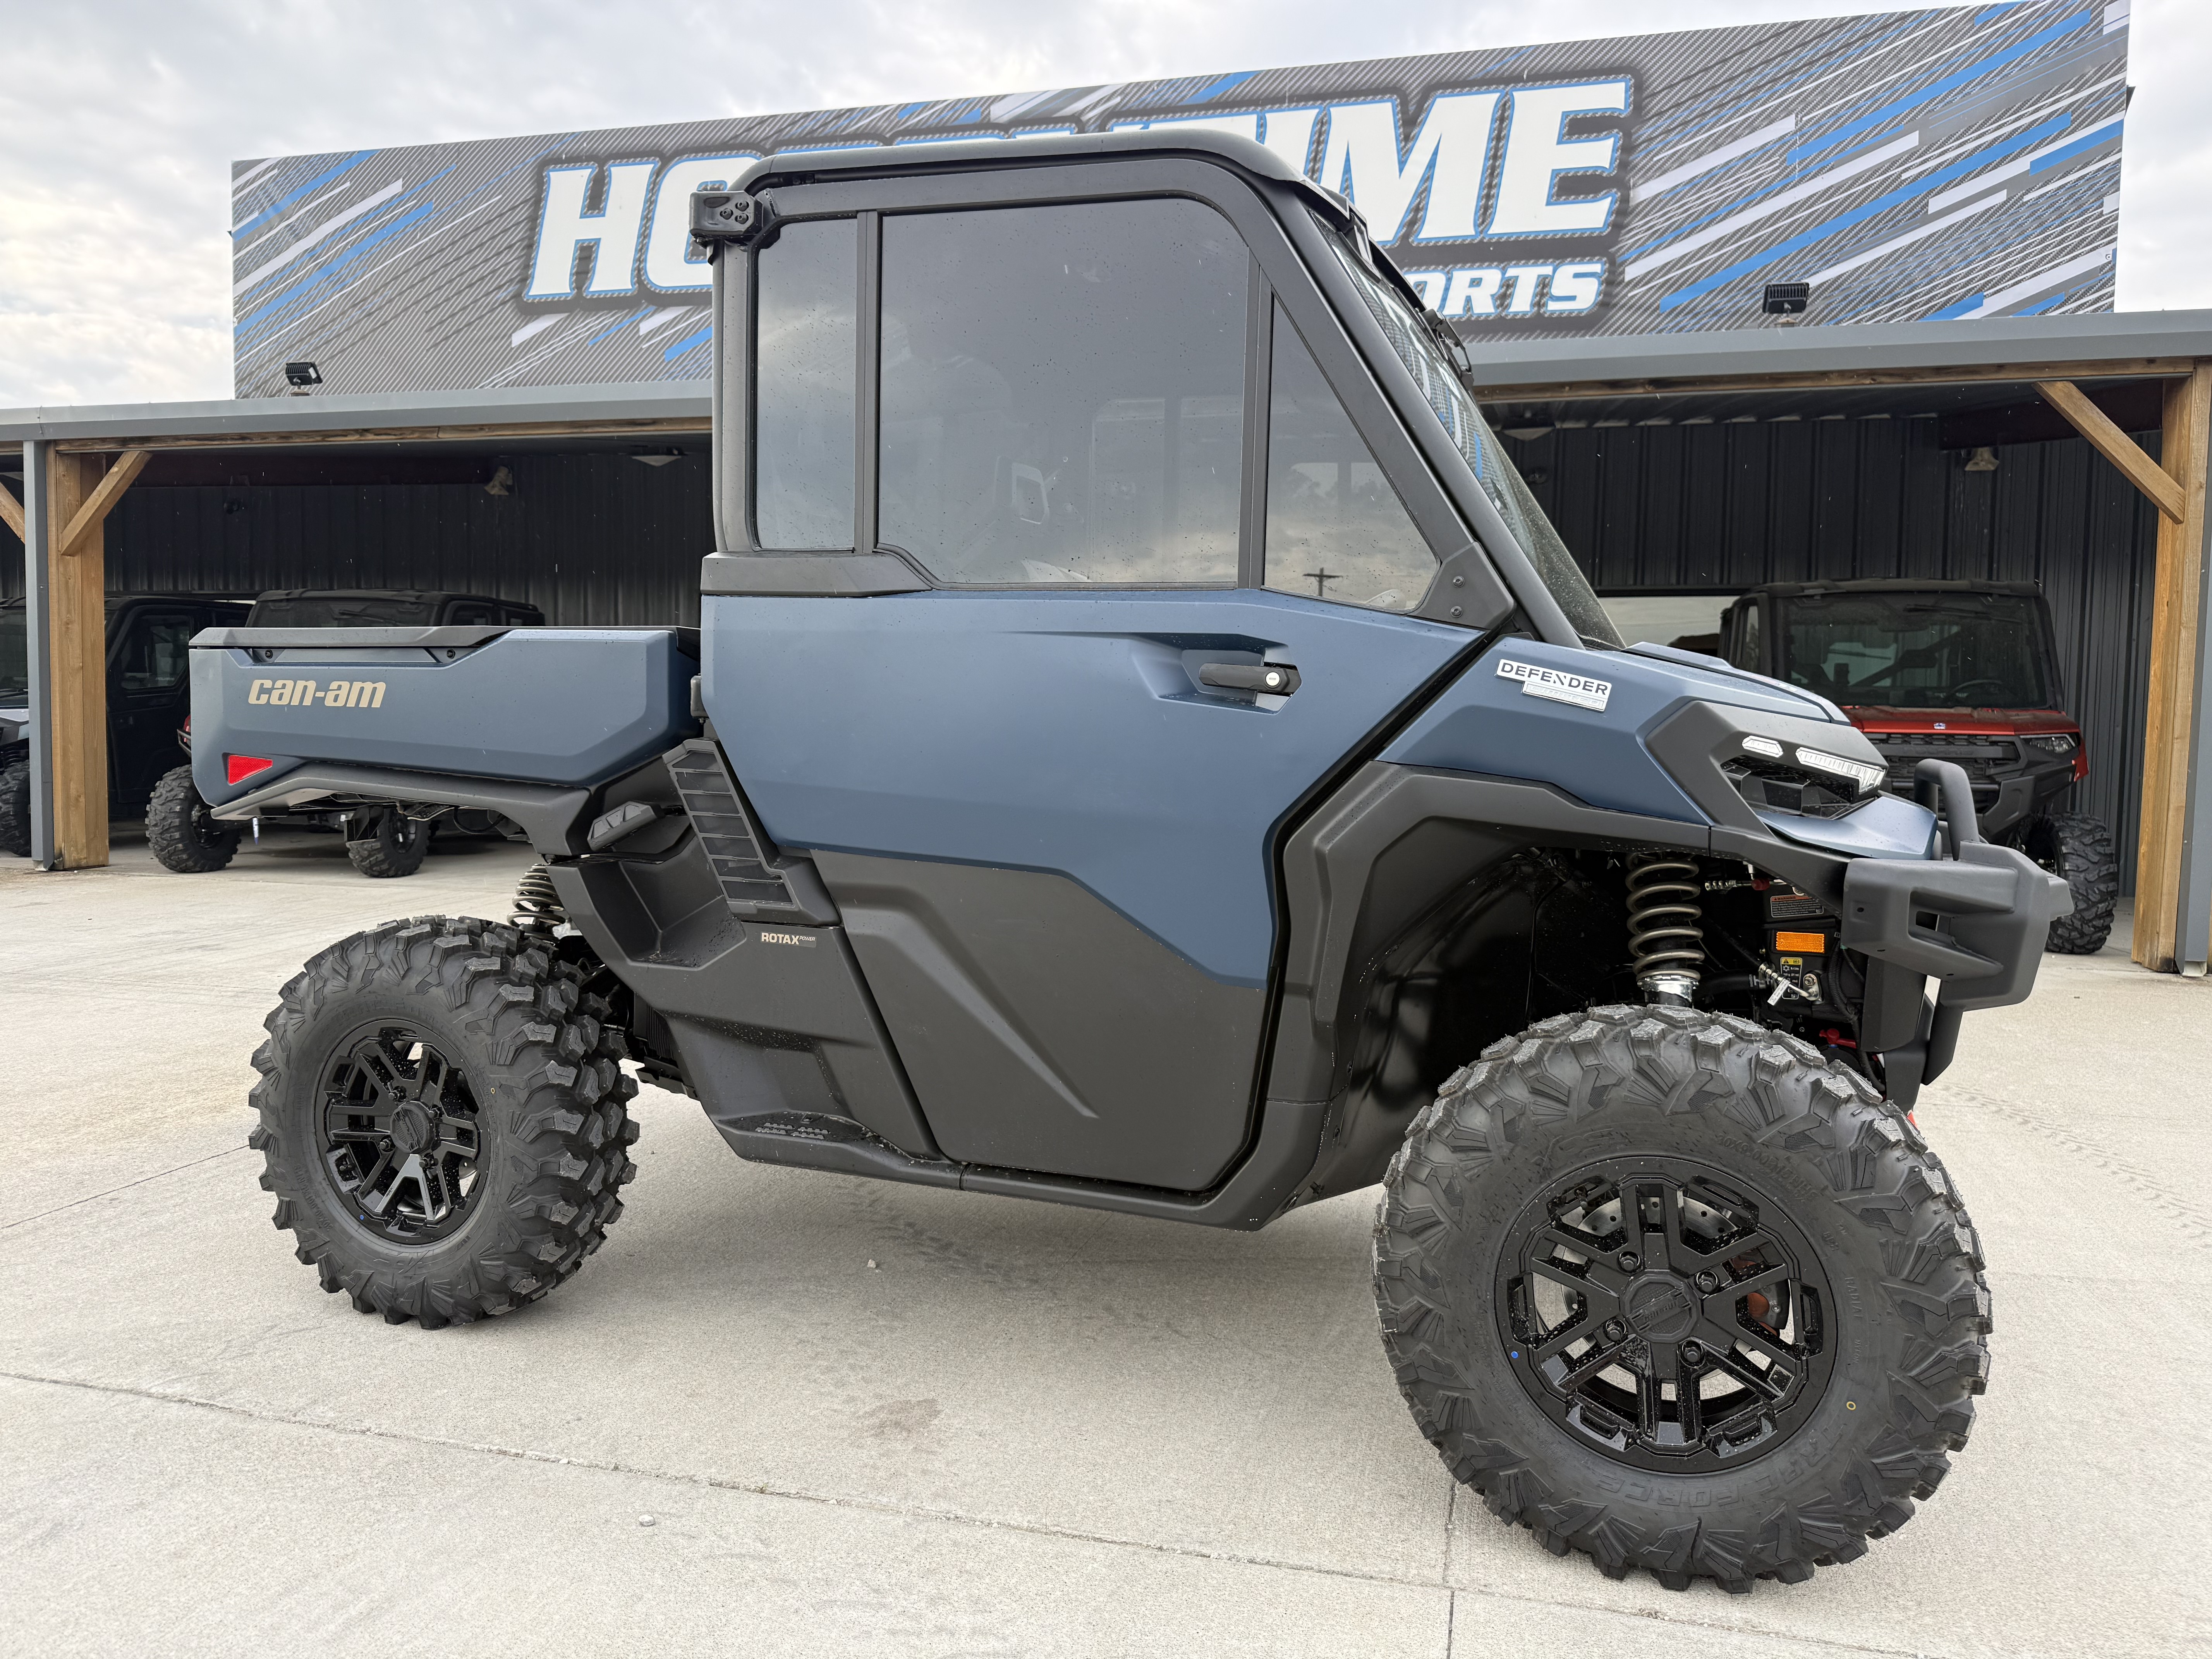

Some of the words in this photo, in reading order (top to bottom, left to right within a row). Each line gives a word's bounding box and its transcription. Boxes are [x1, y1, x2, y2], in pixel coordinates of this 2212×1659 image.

[1501, 662, 1608, 695] DEFENDER
[248, 679, 386, 708] can-am
[761, 932, 799, 945] ROTAX
